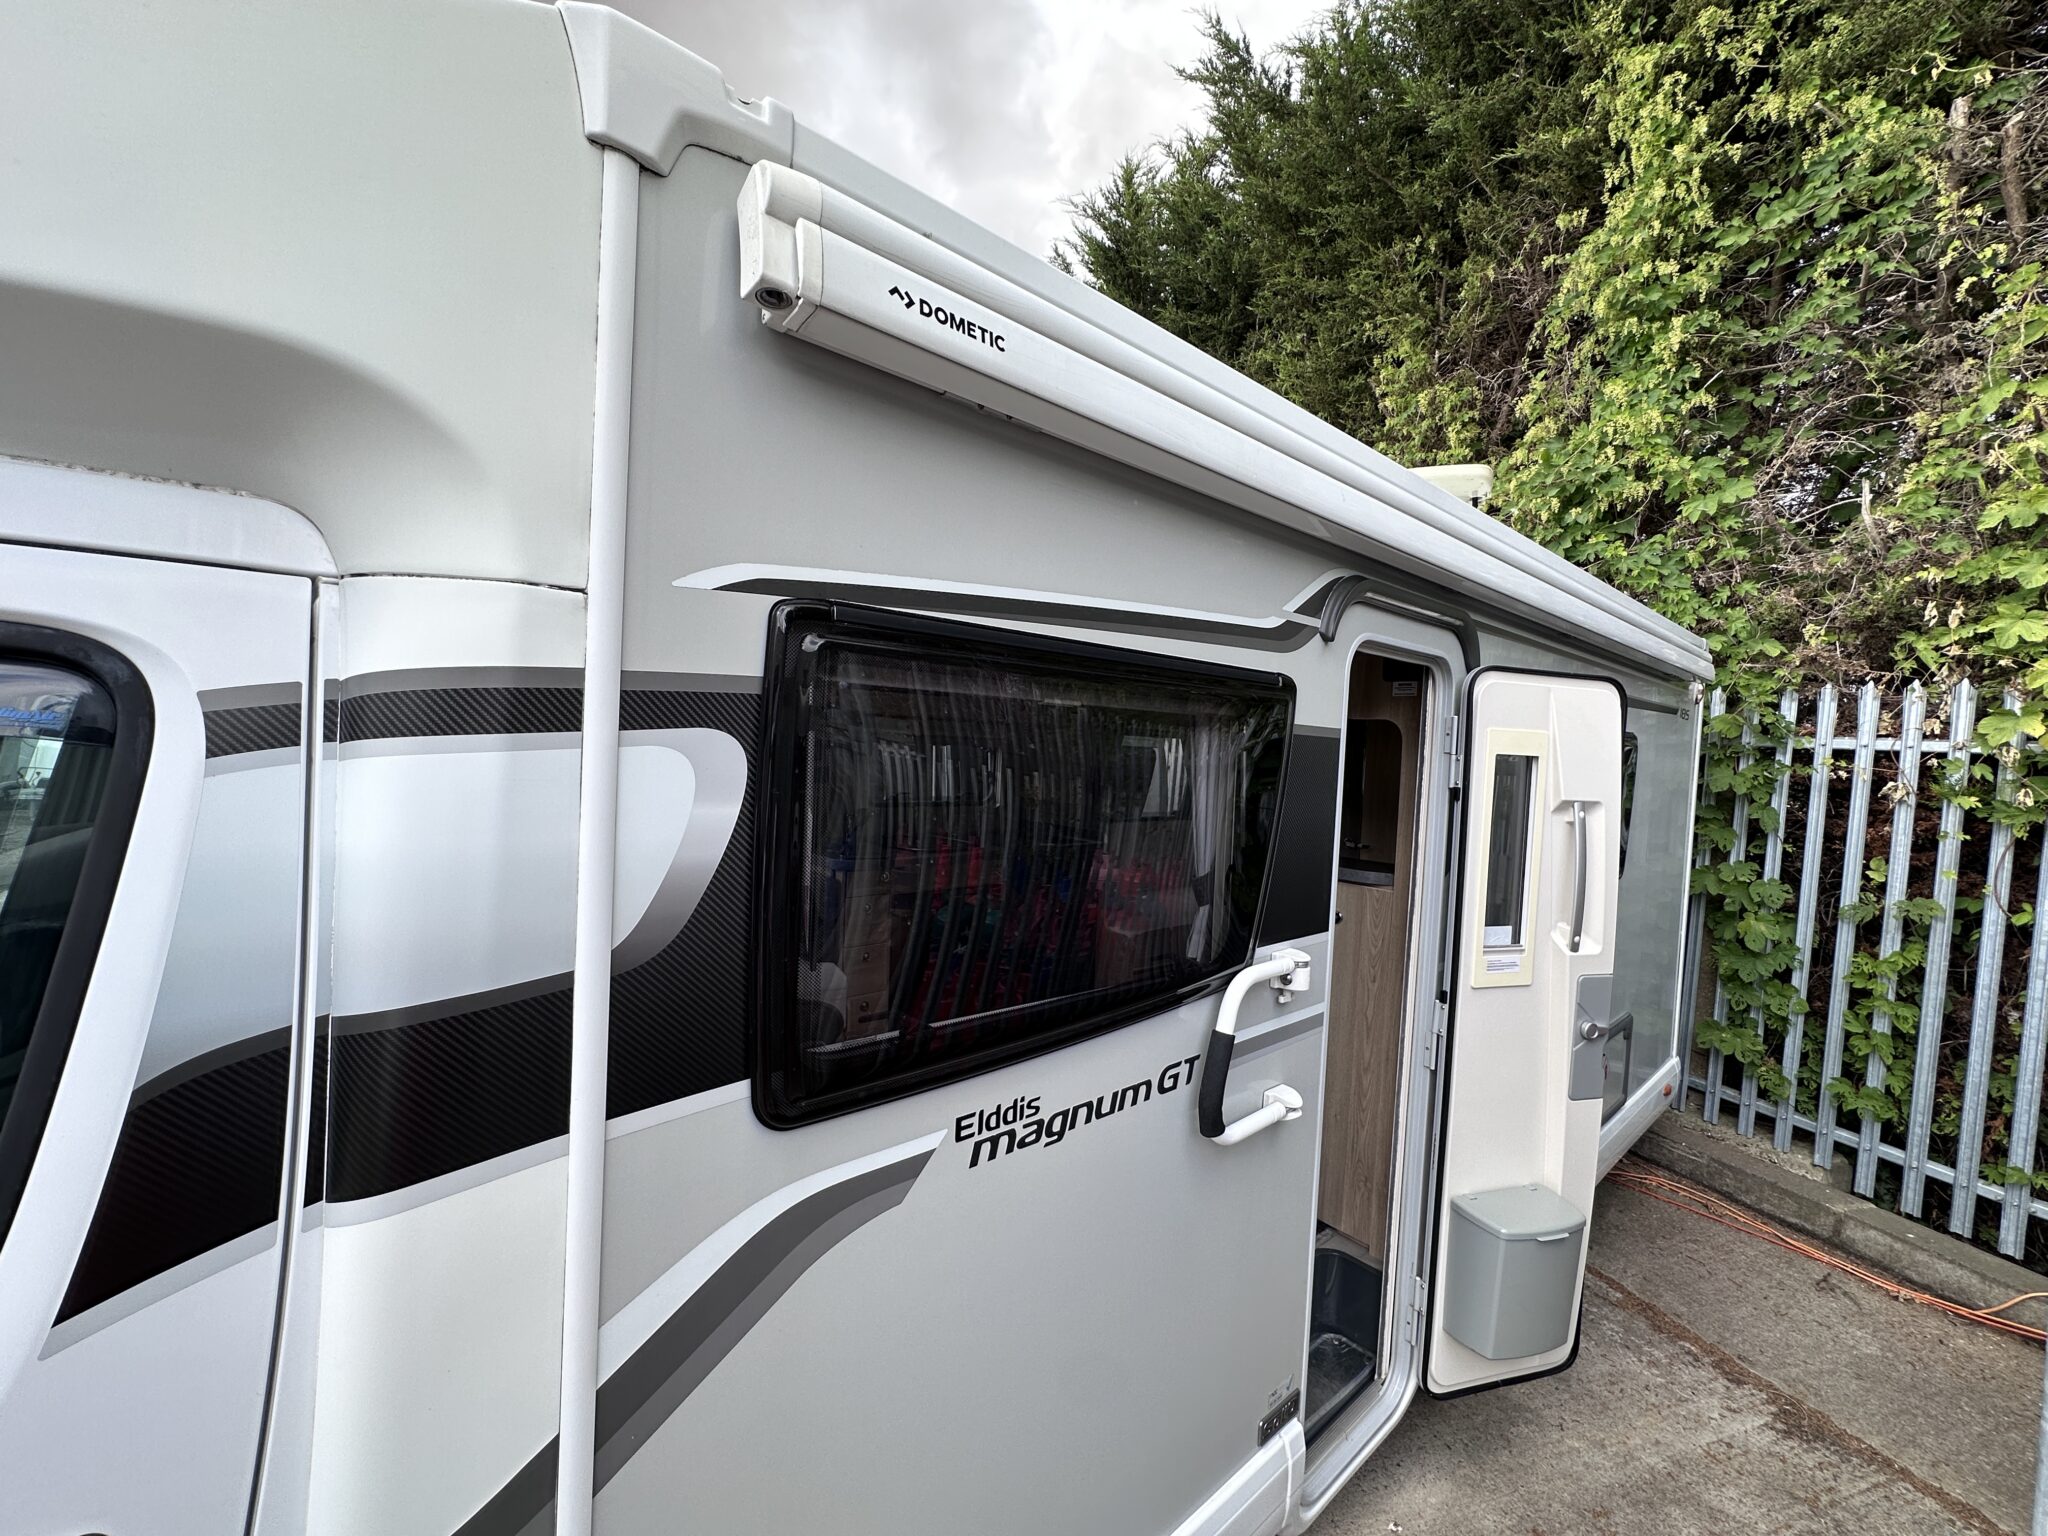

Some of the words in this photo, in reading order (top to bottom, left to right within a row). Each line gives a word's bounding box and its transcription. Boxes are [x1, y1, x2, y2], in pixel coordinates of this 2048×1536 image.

[919, 298, 1006, 352] DOMETIC
[955, 1095, 1041, 1143] Elddis
[969, 1078, 1152, 1169] magnum
[1157, 1054, 1201, 1094] GT
